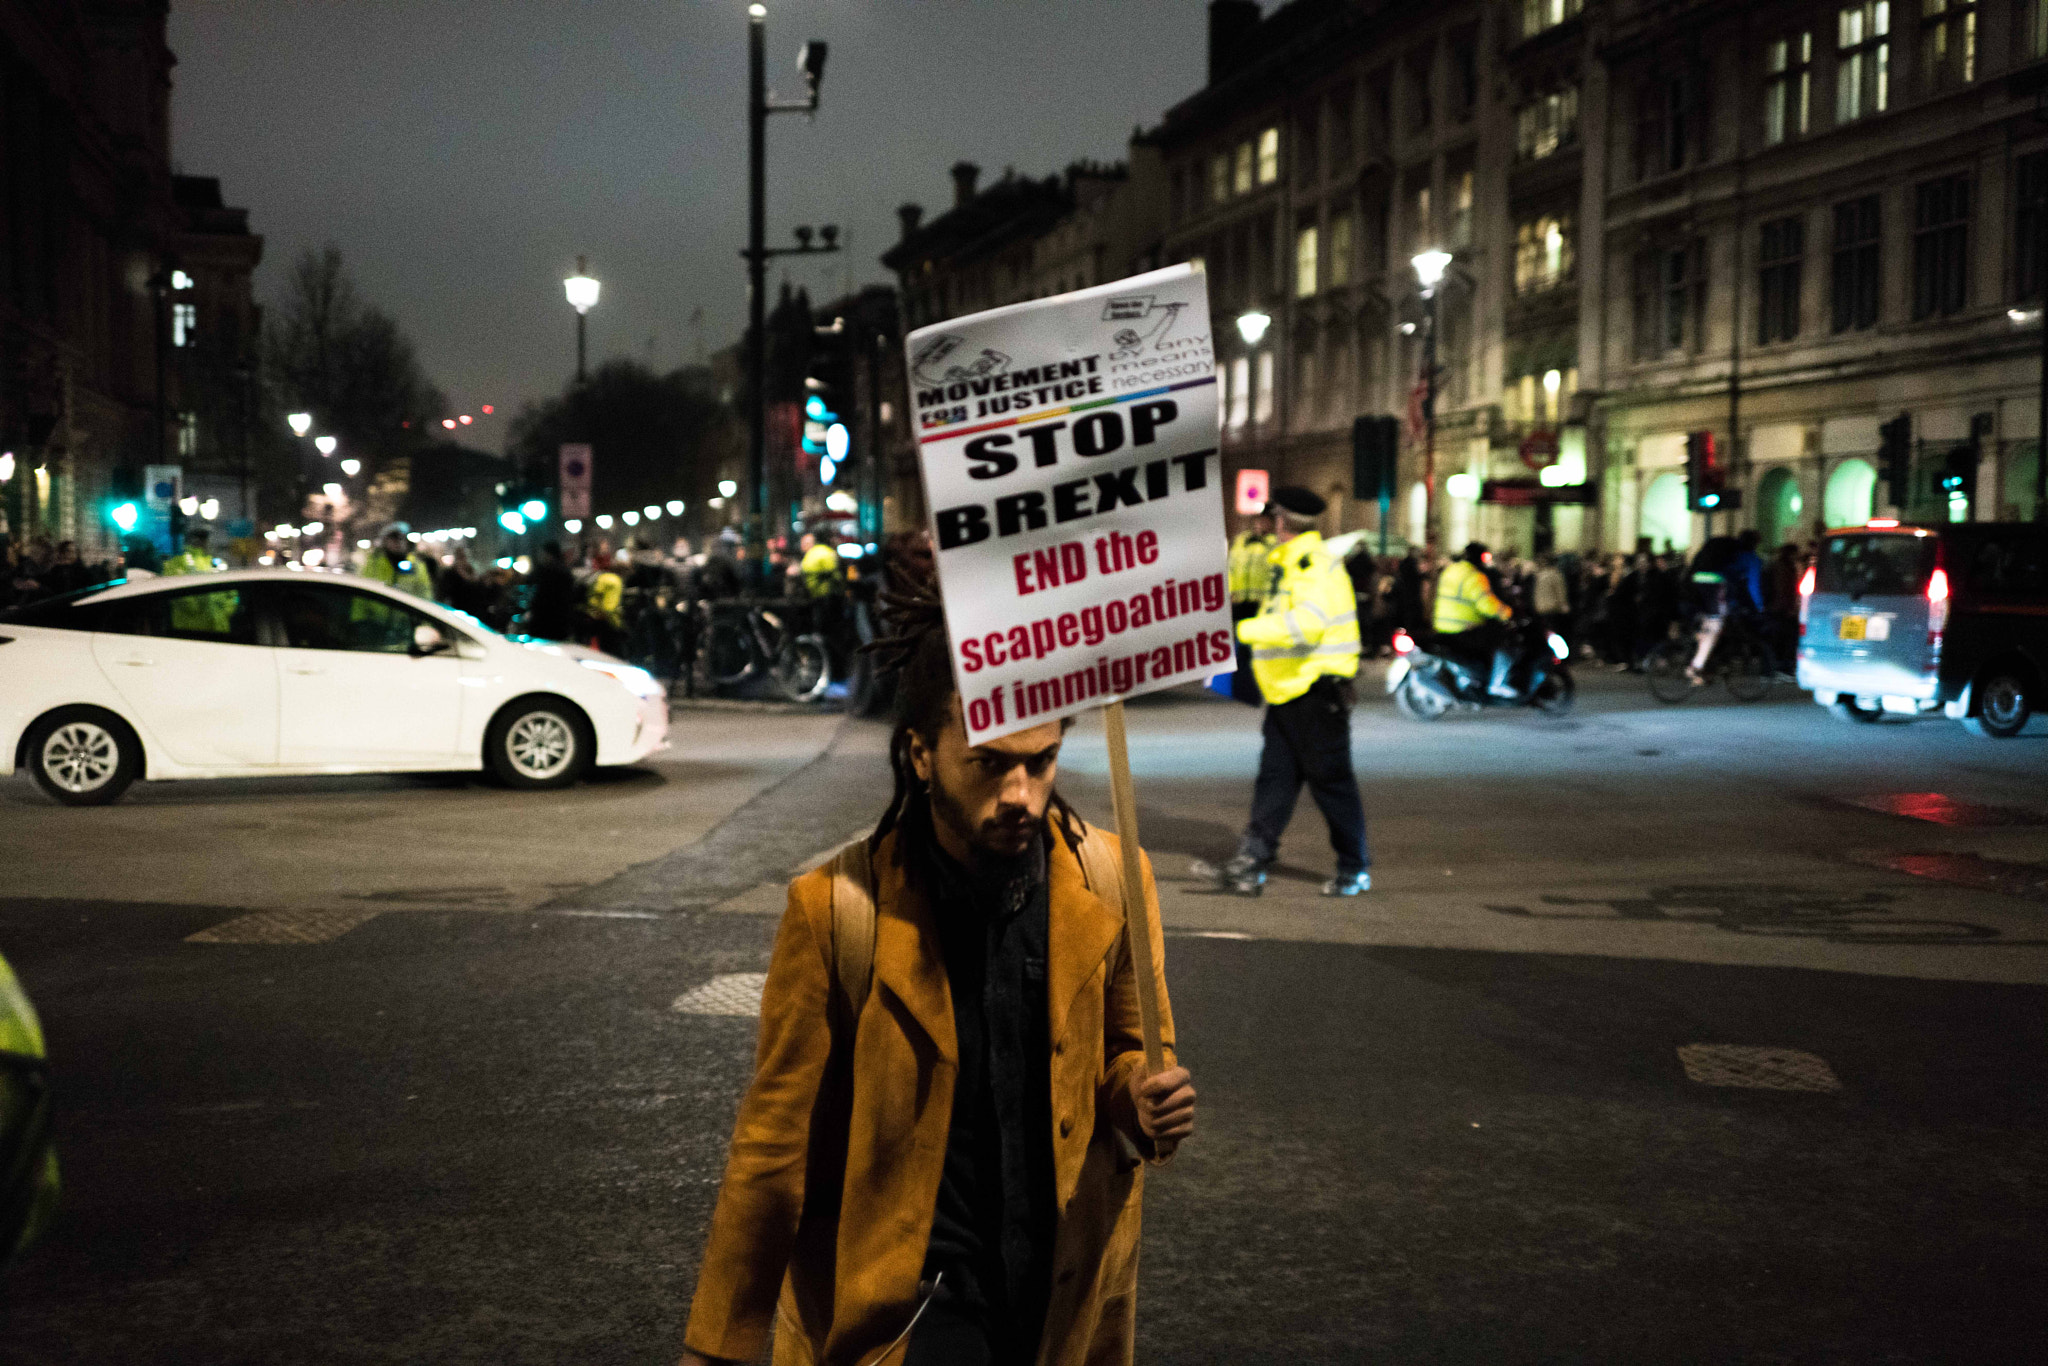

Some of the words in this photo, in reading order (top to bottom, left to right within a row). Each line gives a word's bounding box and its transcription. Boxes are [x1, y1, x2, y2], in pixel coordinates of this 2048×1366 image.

[1112, 347, 1211, 372] means
[1155, 335, 1209, 350] any
[918, 355, 1099, 408] MOVEMENT
[921, 405, 967, 427] FOR
[978, 377, 1103, 417] JUSTICE
[1112, 360, 1214, 388] necessary
[964, 400, 1178, 480] STOP
[936, 448, 1218, 550] BREXIT
[1013, 541, 1087, 596] END
[1096, 530, 1159, 575] the
[960, 573, 1224, 673] scapegoating
[968, 686, 1004, 732] of
[1013, 629, 1231, 719] immigrants
